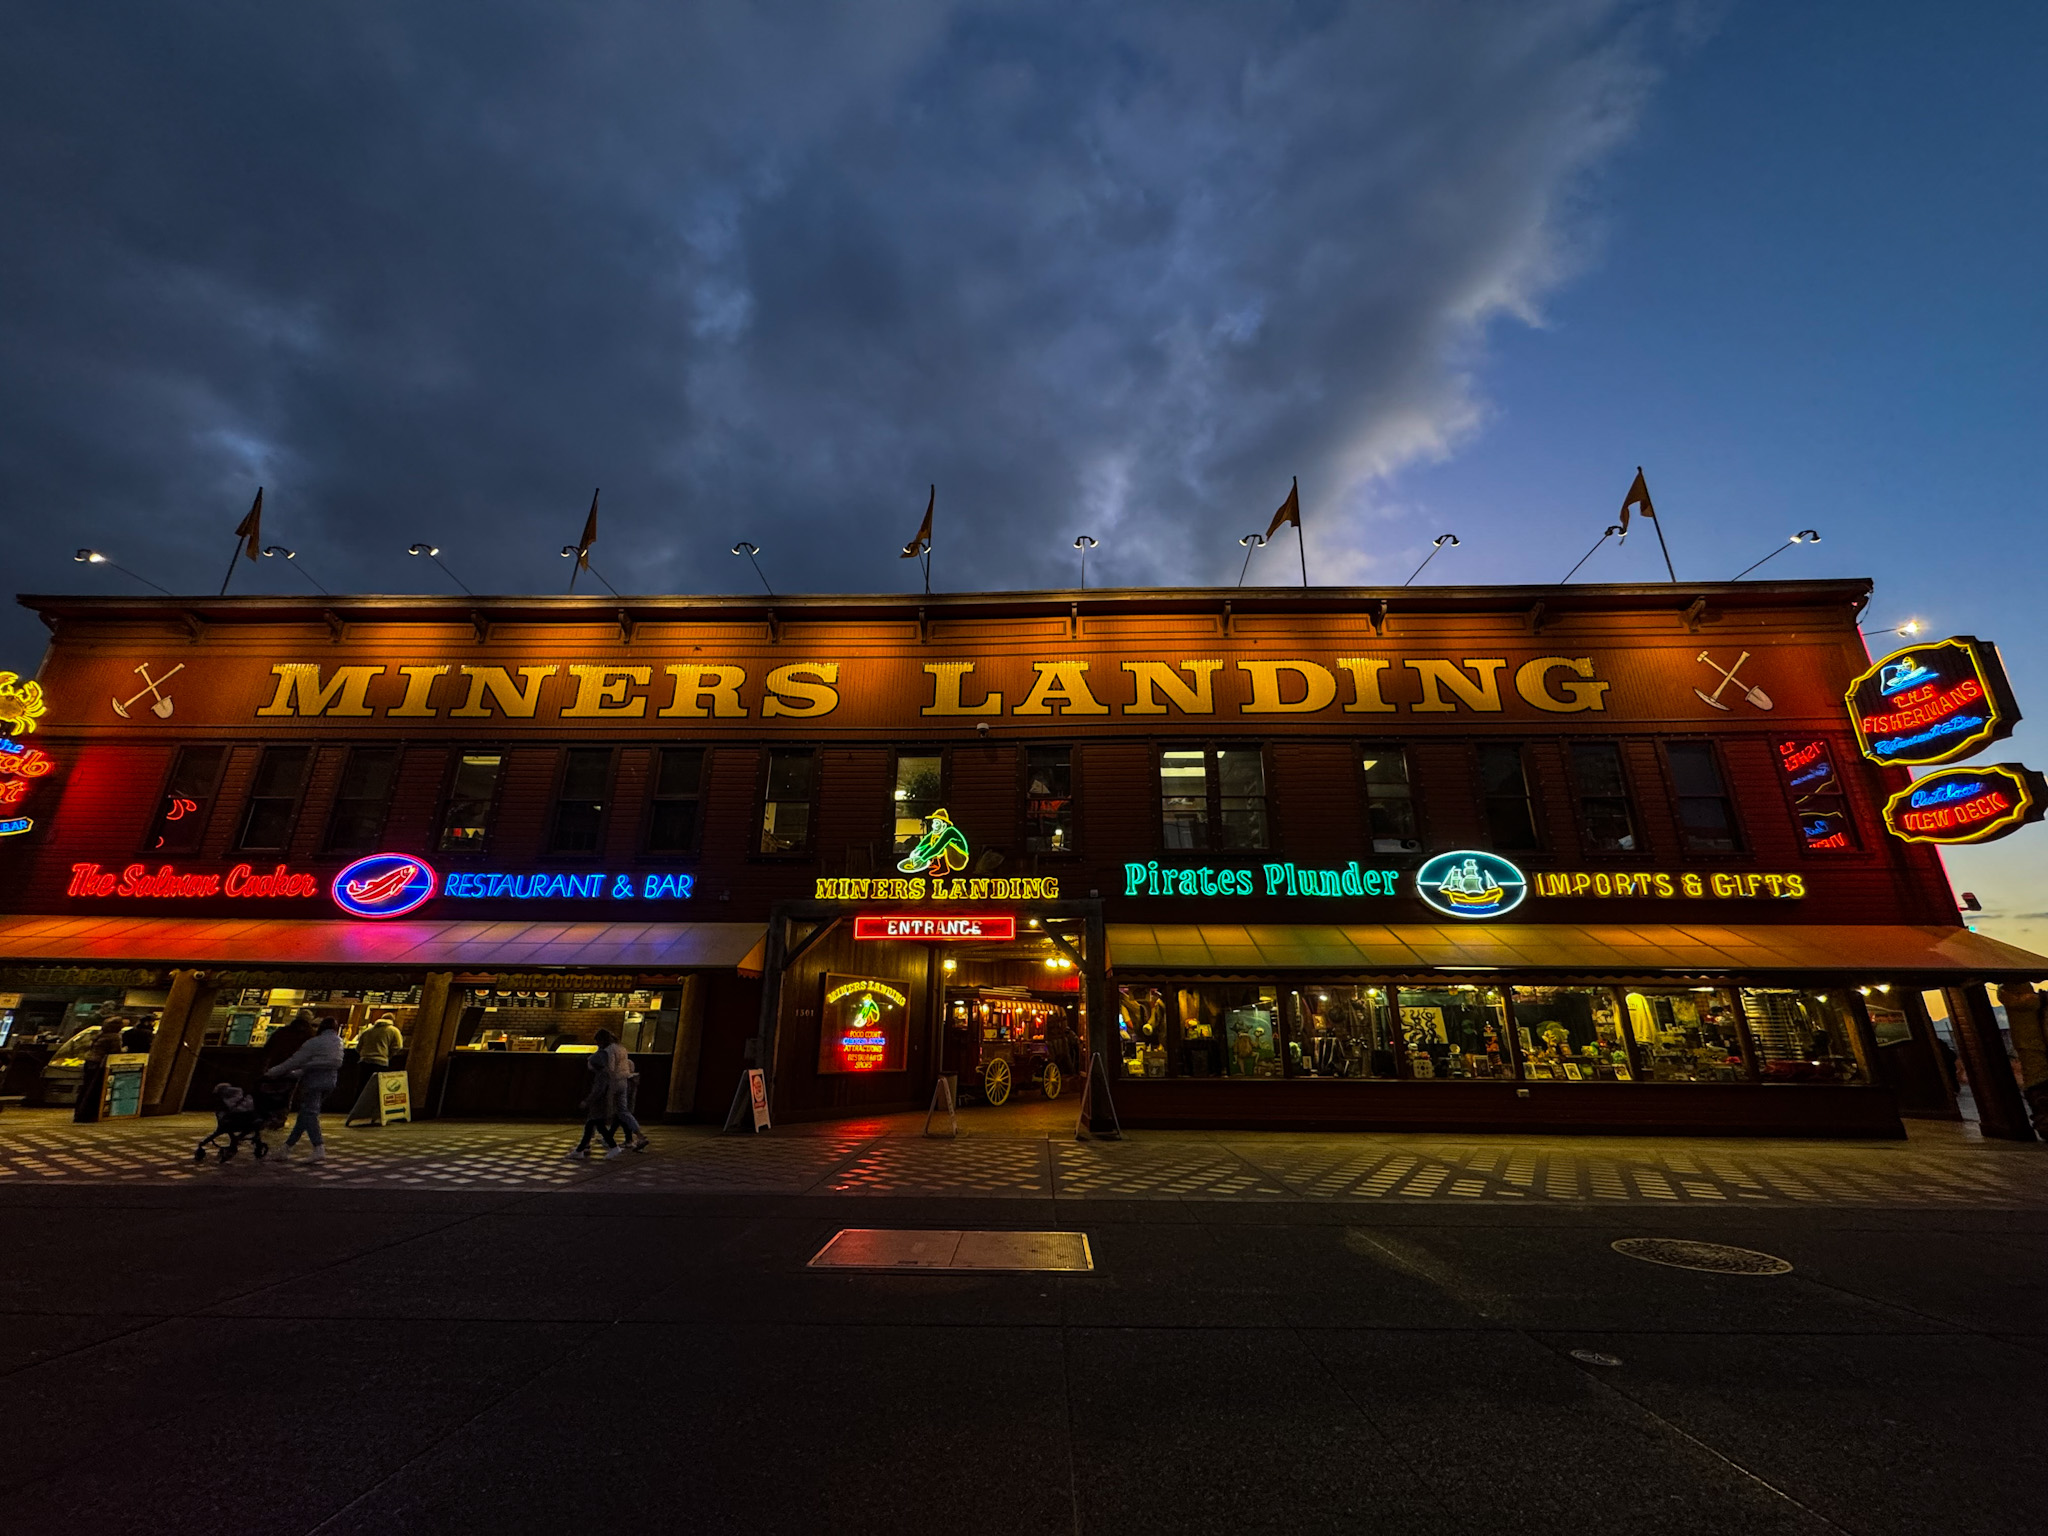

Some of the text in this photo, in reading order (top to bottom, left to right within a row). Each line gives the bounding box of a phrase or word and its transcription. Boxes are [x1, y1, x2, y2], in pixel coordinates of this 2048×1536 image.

[256, 656, 1611, 718] MINERS LANDING
[1862, 680, 1979, 733] FISHERMANS
[1911, 781, 1985, 809] Outdoor
[1903, 791, 2010, 831] VIEW DECK
[67, 863, 319, 898] The Salmon Cooker
[444, 873, 694, 899] RESTAURANT & BAR
[814, 876, 1060, 900] MINERS LANDING
[1124, 860, 1400, 897] Pirates Plunder
[1535, 872, 1807, 899] IMPORTS & GIFTS
[886, 919, 984, 936] ENTRANCE
[826, 980, 907, 1007] MINERS LANDING
